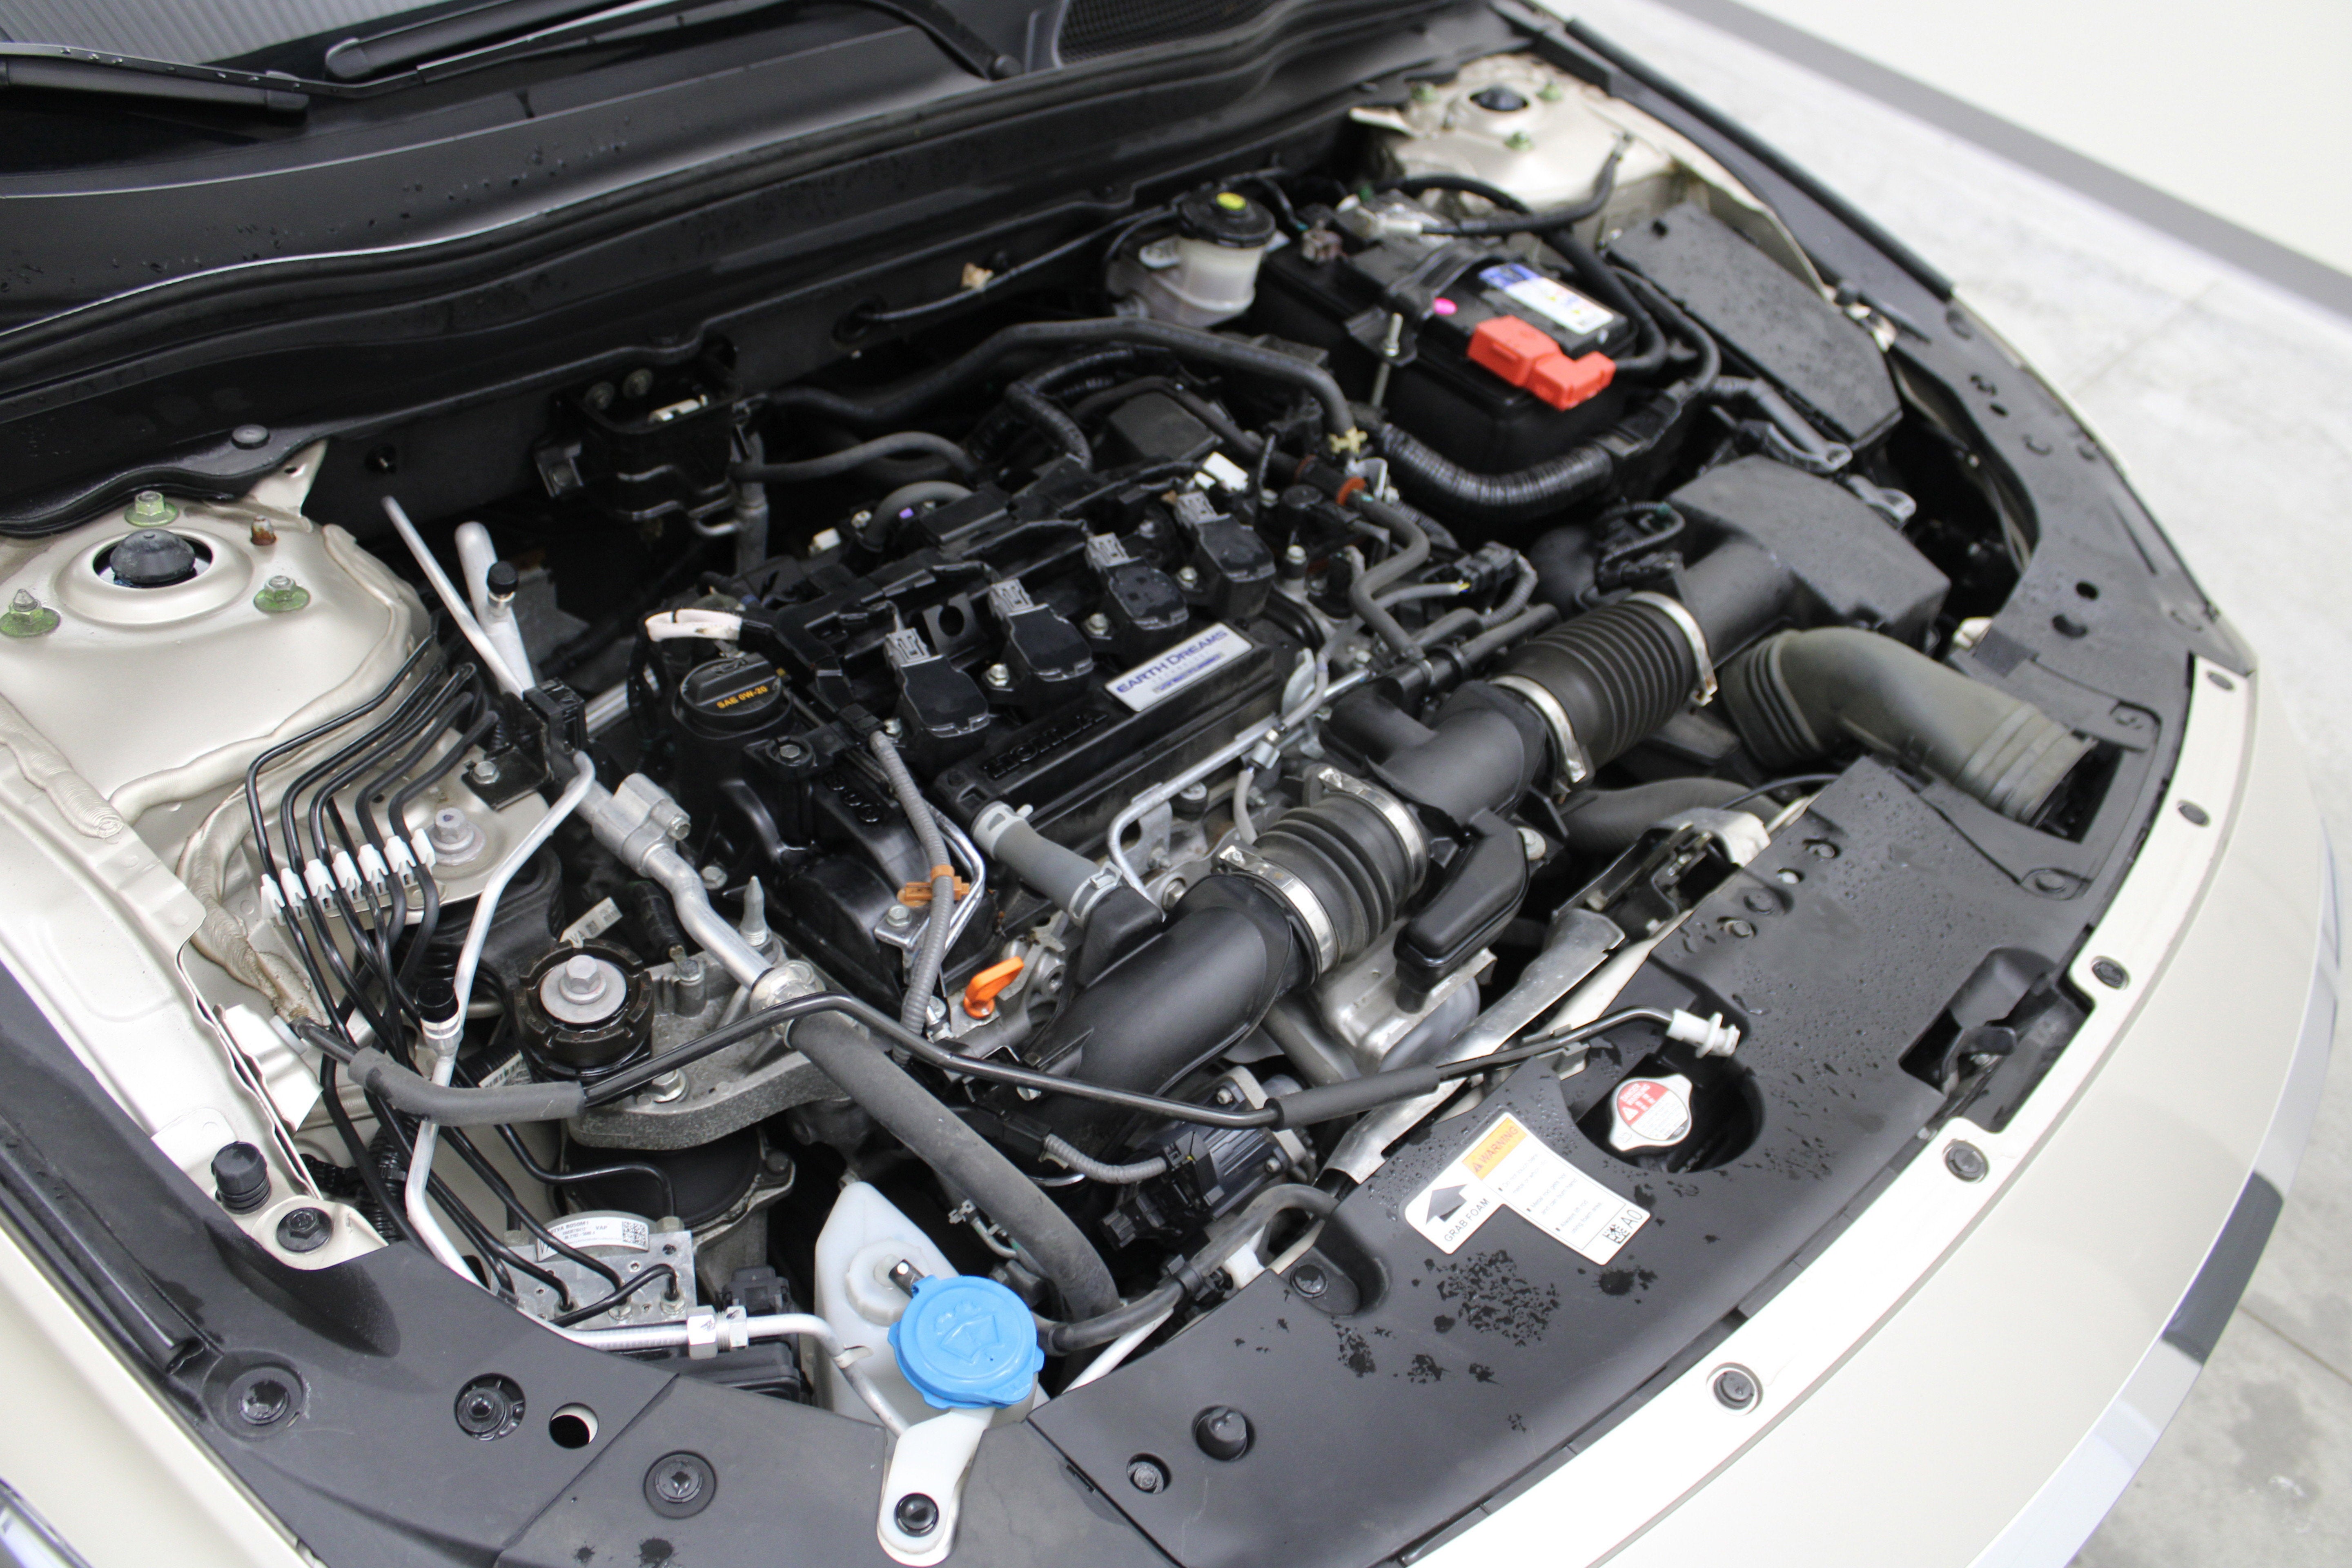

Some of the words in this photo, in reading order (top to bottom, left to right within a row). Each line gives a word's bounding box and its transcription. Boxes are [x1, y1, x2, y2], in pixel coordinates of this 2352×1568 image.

[1117, 662, 1168, 693] EARTH
[1167, 631, 1227, 665] DREAMS
[716, 696, 738, 708] SAE
[1479, 1126, 1519, 1163] WARNING
[1444, 1219, 1468, 1241] GRAB
[1466, 1198, 1490, 1221] FOAM
